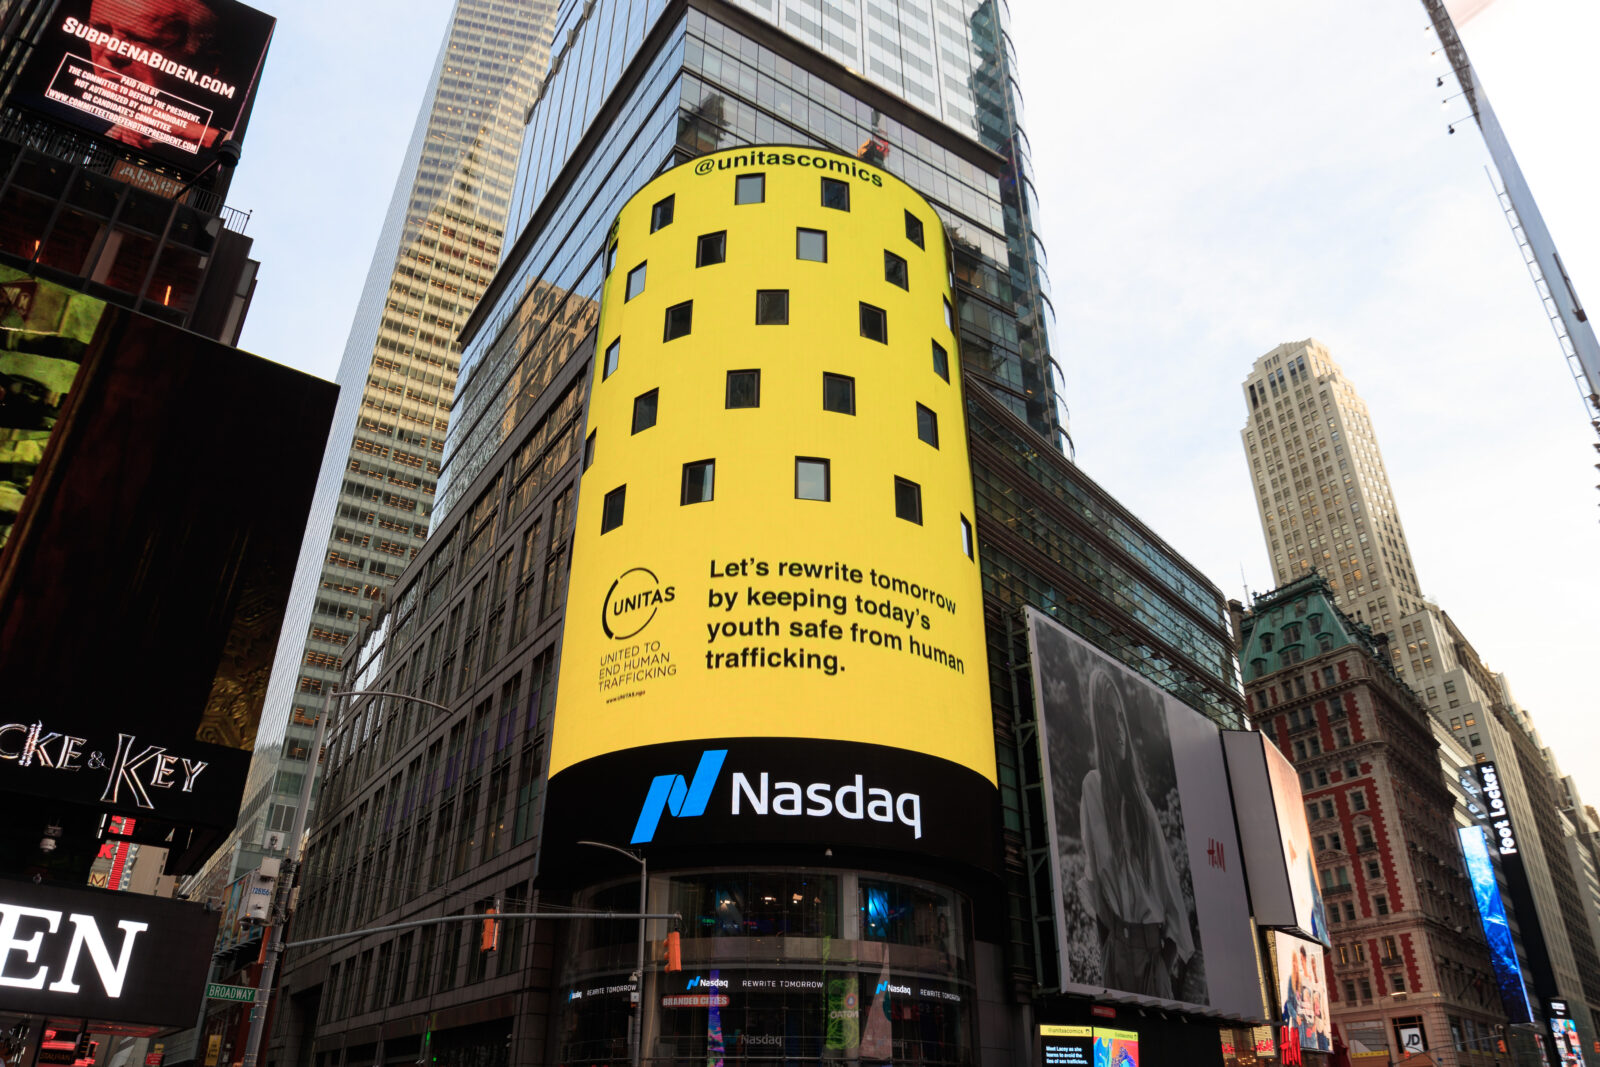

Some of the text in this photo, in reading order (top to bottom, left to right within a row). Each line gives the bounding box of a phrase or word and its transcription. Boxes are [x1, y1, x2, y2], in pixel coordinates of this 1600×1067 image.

[68, 65, 201, 124] THE COMMITTEE TO DEFEND THE PRESIDENT.
[120, 76, 160, 97] PAID FOR BY
[74, 78, 189, 129] NOT AUTHORIZED BY ANY CANDIDATE
[81, 92, 173, 133] OR CANDIDATE'S COMMITTEE.
[694, 151, 883, 188] @unitascomics
[613, 586, 676, 617] UNITAS
[708, 588, 739, 612] by
[747, 587, 848, 615] keeping
[778, 561, 863, 584] rewrite
[870, 568, 957, 616] tomorrow
[600, 640, 661, 667] UNITED TO
[707, 617, 965, 675] youth safe from human
[599, 652, 671, 680] END HUMAN
[705, 647, 846, 676] trafficking.
[598, 664, 677, 693] TRAFFICKING
[88, 750, 110, 770] &
[100, 733, 209, 810] KEY
[731, 772, 922, 840] Nasdaq
[0, 903, 149, 998] EN
[208, 985, 254, 1001] BROADWAY
[606, 984, 637, 994] TOMORROW
[700, 978, 824, 989] Nasdaq REWRITE TOMORROW
[887, 984, 911, 996] Nasdaq
[920, 988, 941, 998] REWRITE
[662, 996, 728, 1006] BRANDED CITIES
[740, 1033, 783, 1048] Nasdaq
[1406, 1034, 1420, 1047] JD
